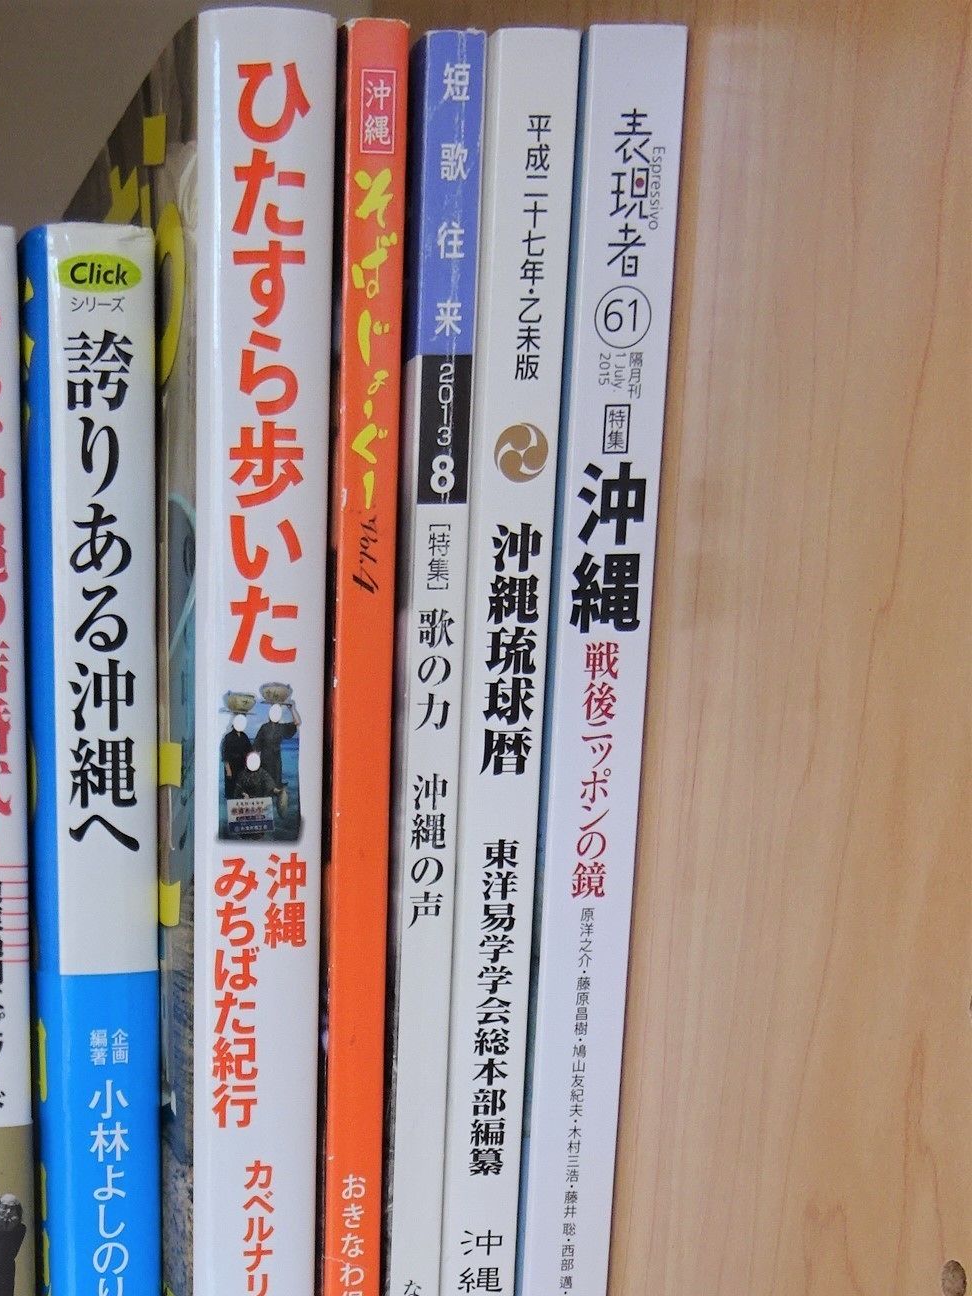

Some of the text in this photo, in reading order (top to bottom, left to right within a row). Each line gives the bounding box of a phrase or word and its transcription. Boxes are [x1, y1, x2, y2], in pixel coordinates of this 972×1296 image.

[365, 80, 392, 146] 沖縄
[434, 63, 472, 336] 短歌往来
[514, 113, 552, 382] 平成二十七年・乙未版
[608, 108, 651, 278] 表現者
[647, 145, 666, 231] Espressivo
[70, 261, 128, 288] Click
[70, 296, 126, 313] シリーズ
[603, 298, 640, 334] 61
[228, 61, 312, 665] ひたすら歩いた
[598, 352, 612, 387] 2015
[627, 351, 644, 400] 隔月刊
[429, 364, 456, 495] 2013 8
[607, 408, 626, 450] 特集
[64, 329, 140, 852] 誇りある沖縄へ
[570, 461, 647, 634] 沖縄
[478, 522, 543, 777] 沖縄琉球暦
[407, 607, 455, 929] 歌の力 沖縄の声
[571, 641, 621, 899] 戦後ニッポンの鏡
[263, 853, 308, 950] 沖縄
[90, 1029, 108, 1074] 編著
[112, 1028, 129, 1073] 企画
[211, 857, 260, 1129] みちばた紀行
[469, 838, 520, 1177] 東洋易学学会総本部編纂
